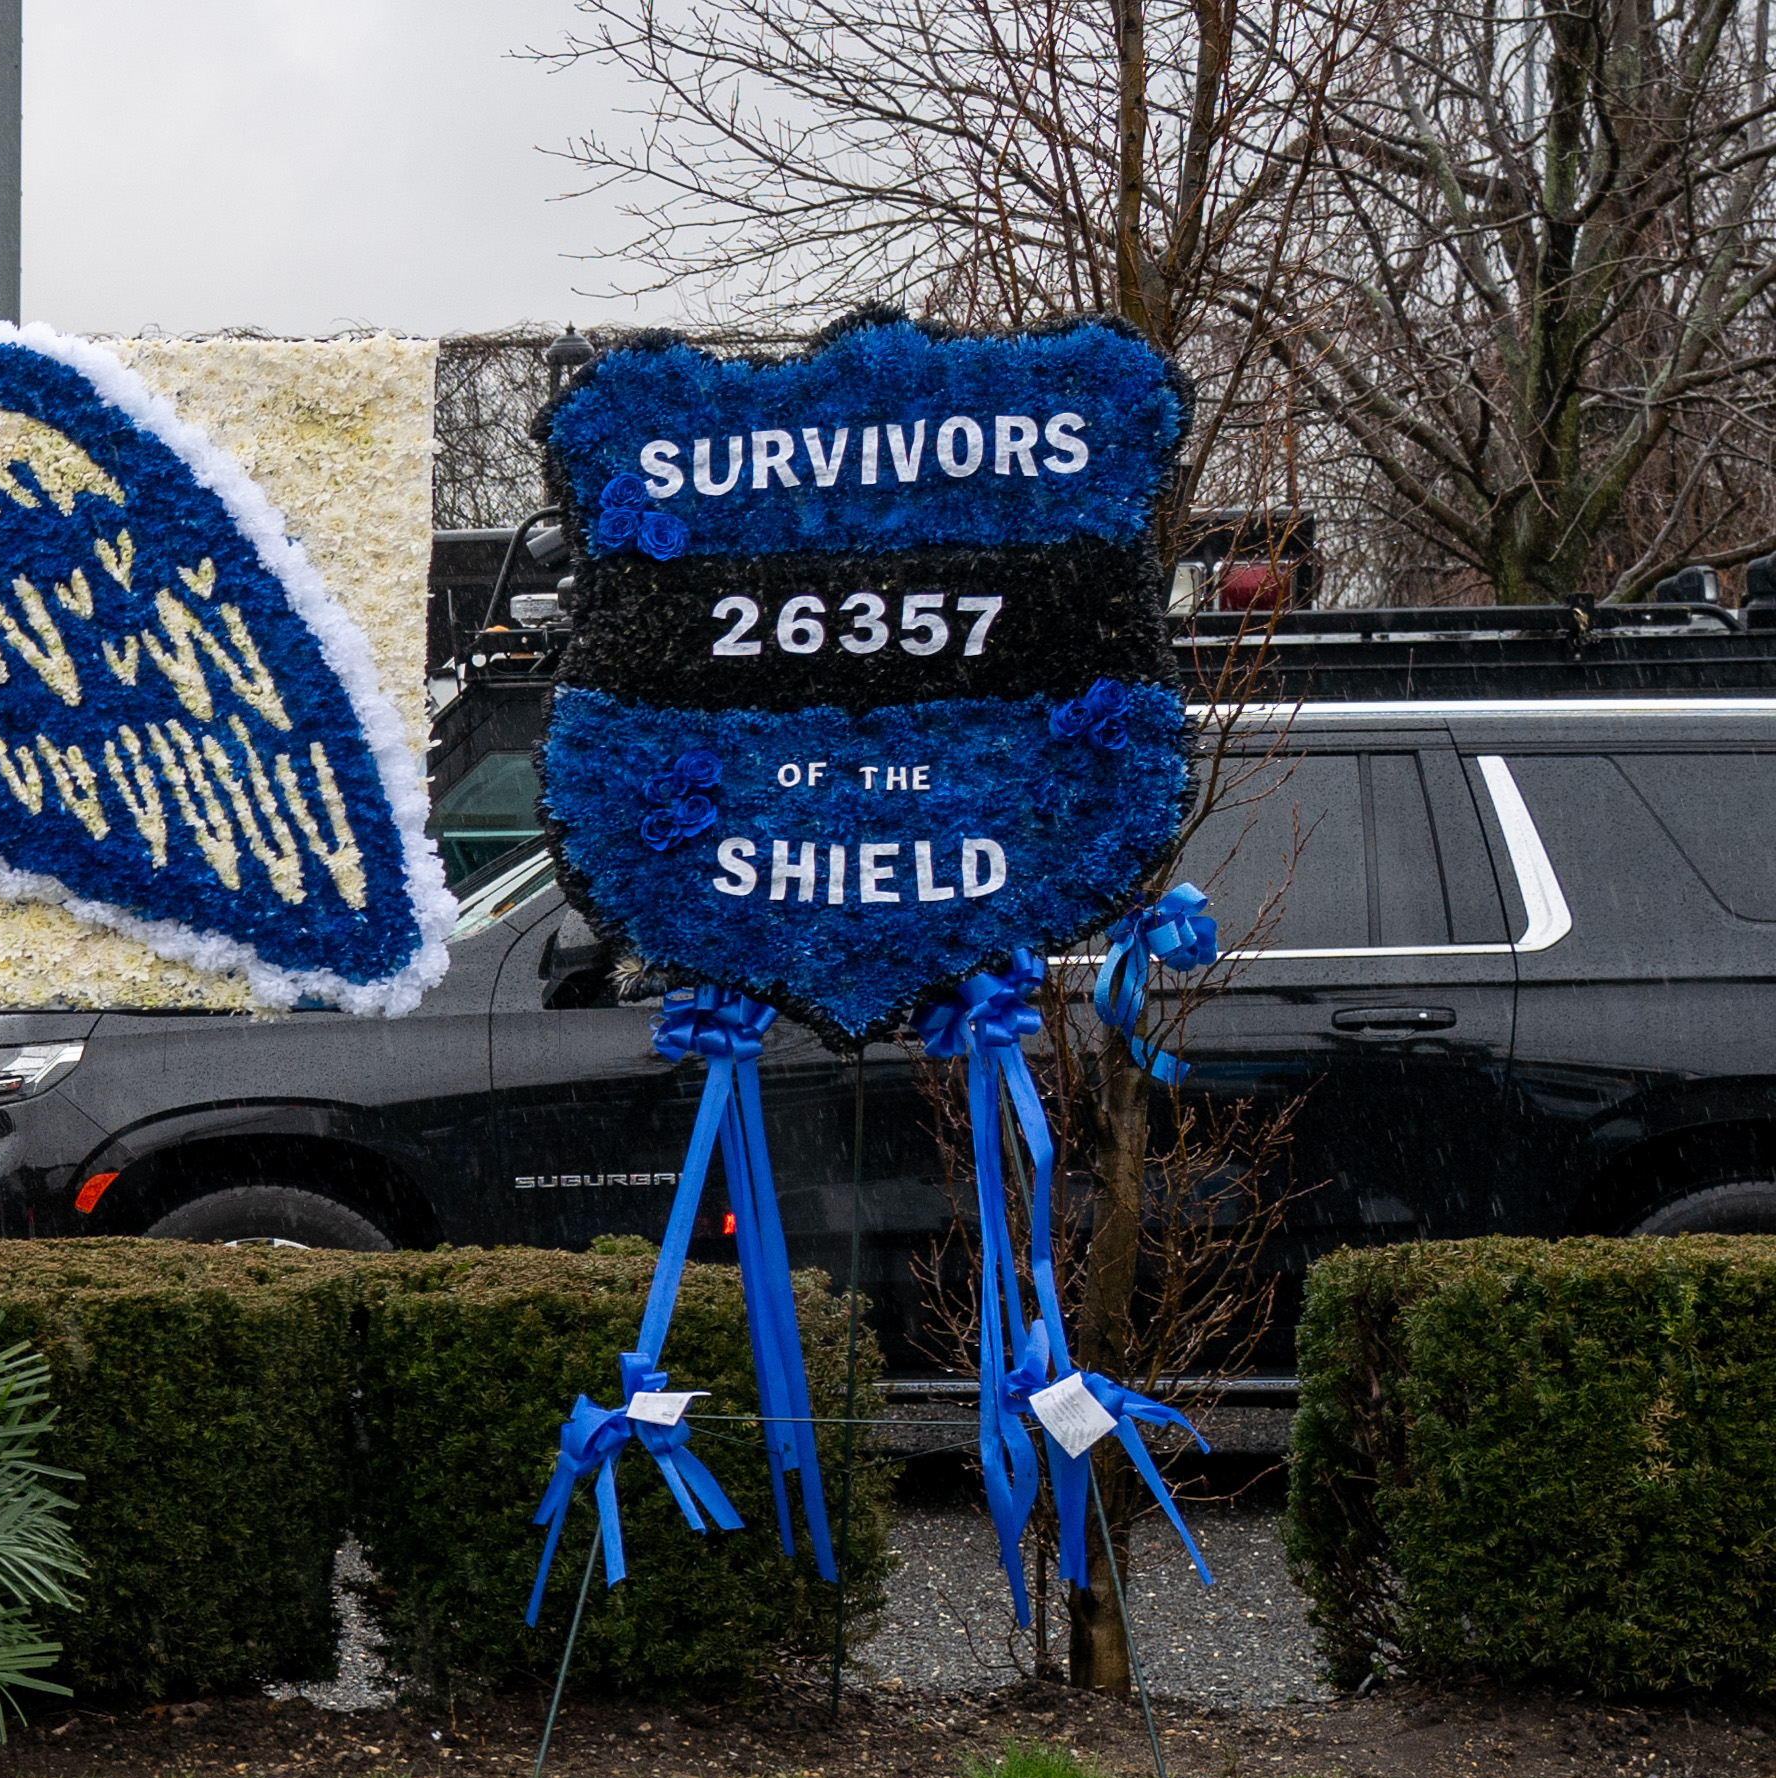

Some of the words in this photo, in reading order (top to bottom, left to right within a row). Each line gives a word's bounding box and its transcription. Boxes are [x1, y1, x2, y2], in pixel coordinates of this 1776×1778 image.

[638, 411, 1090, 500] SURVIVORS
[710, 592, 1004, 657] 26357
[776, 762, 828, 788] OF
[858, 764, 932, 792] THE
[711, 836, 1008, 905] SHIELD
[514, 1172, 684, 1189] SUBURBA
